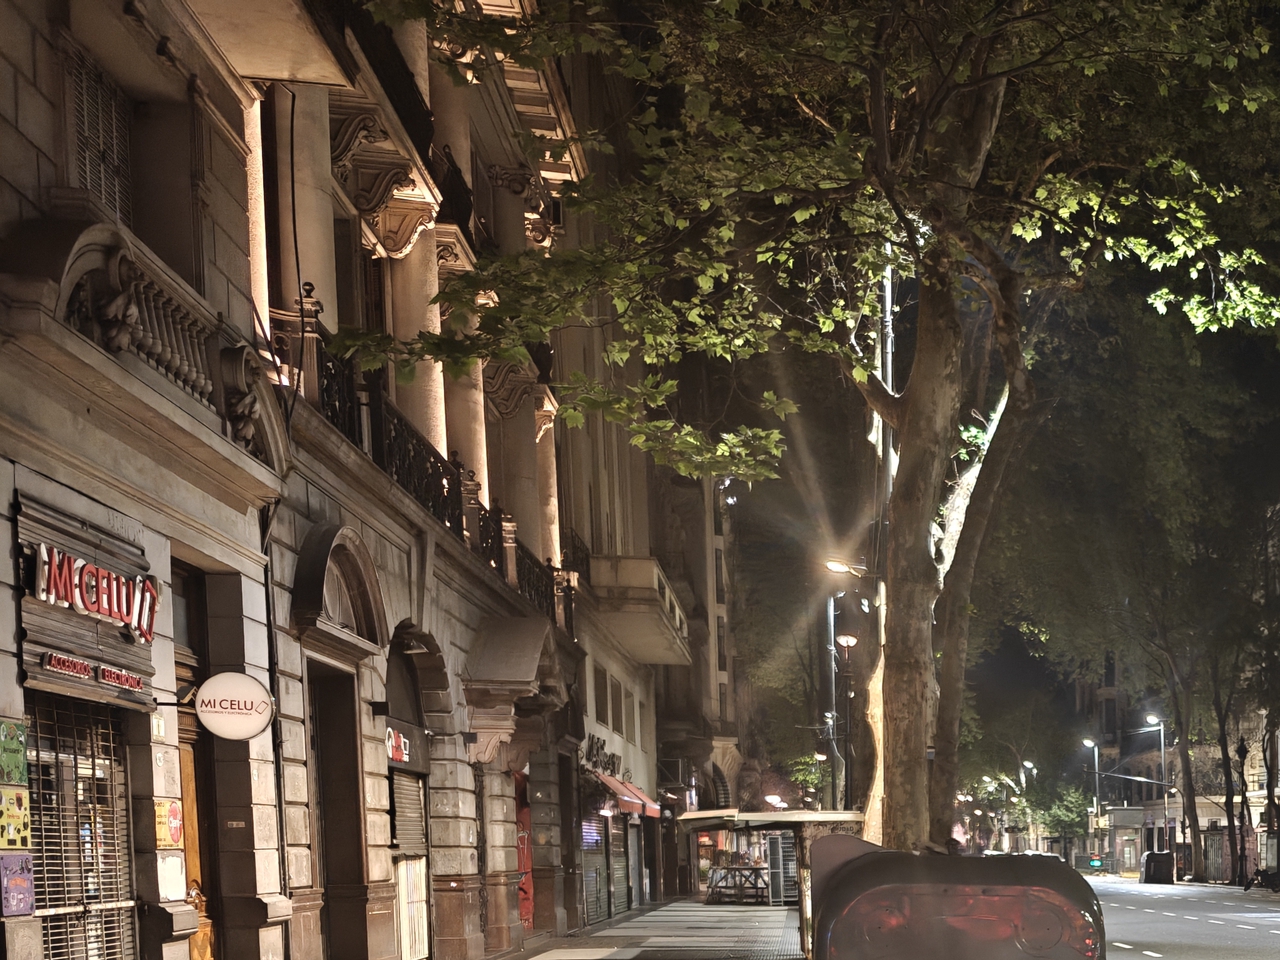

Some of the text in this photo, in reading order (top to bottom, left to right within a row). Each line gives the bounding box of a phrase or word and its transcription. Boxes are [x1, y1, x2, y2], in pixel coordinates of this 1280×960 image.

[47, 547, 133, 624] MI CELU
[50, 655, 92, 676] ACCESORIOS
[200, 699, 253, 711] MI CELU
